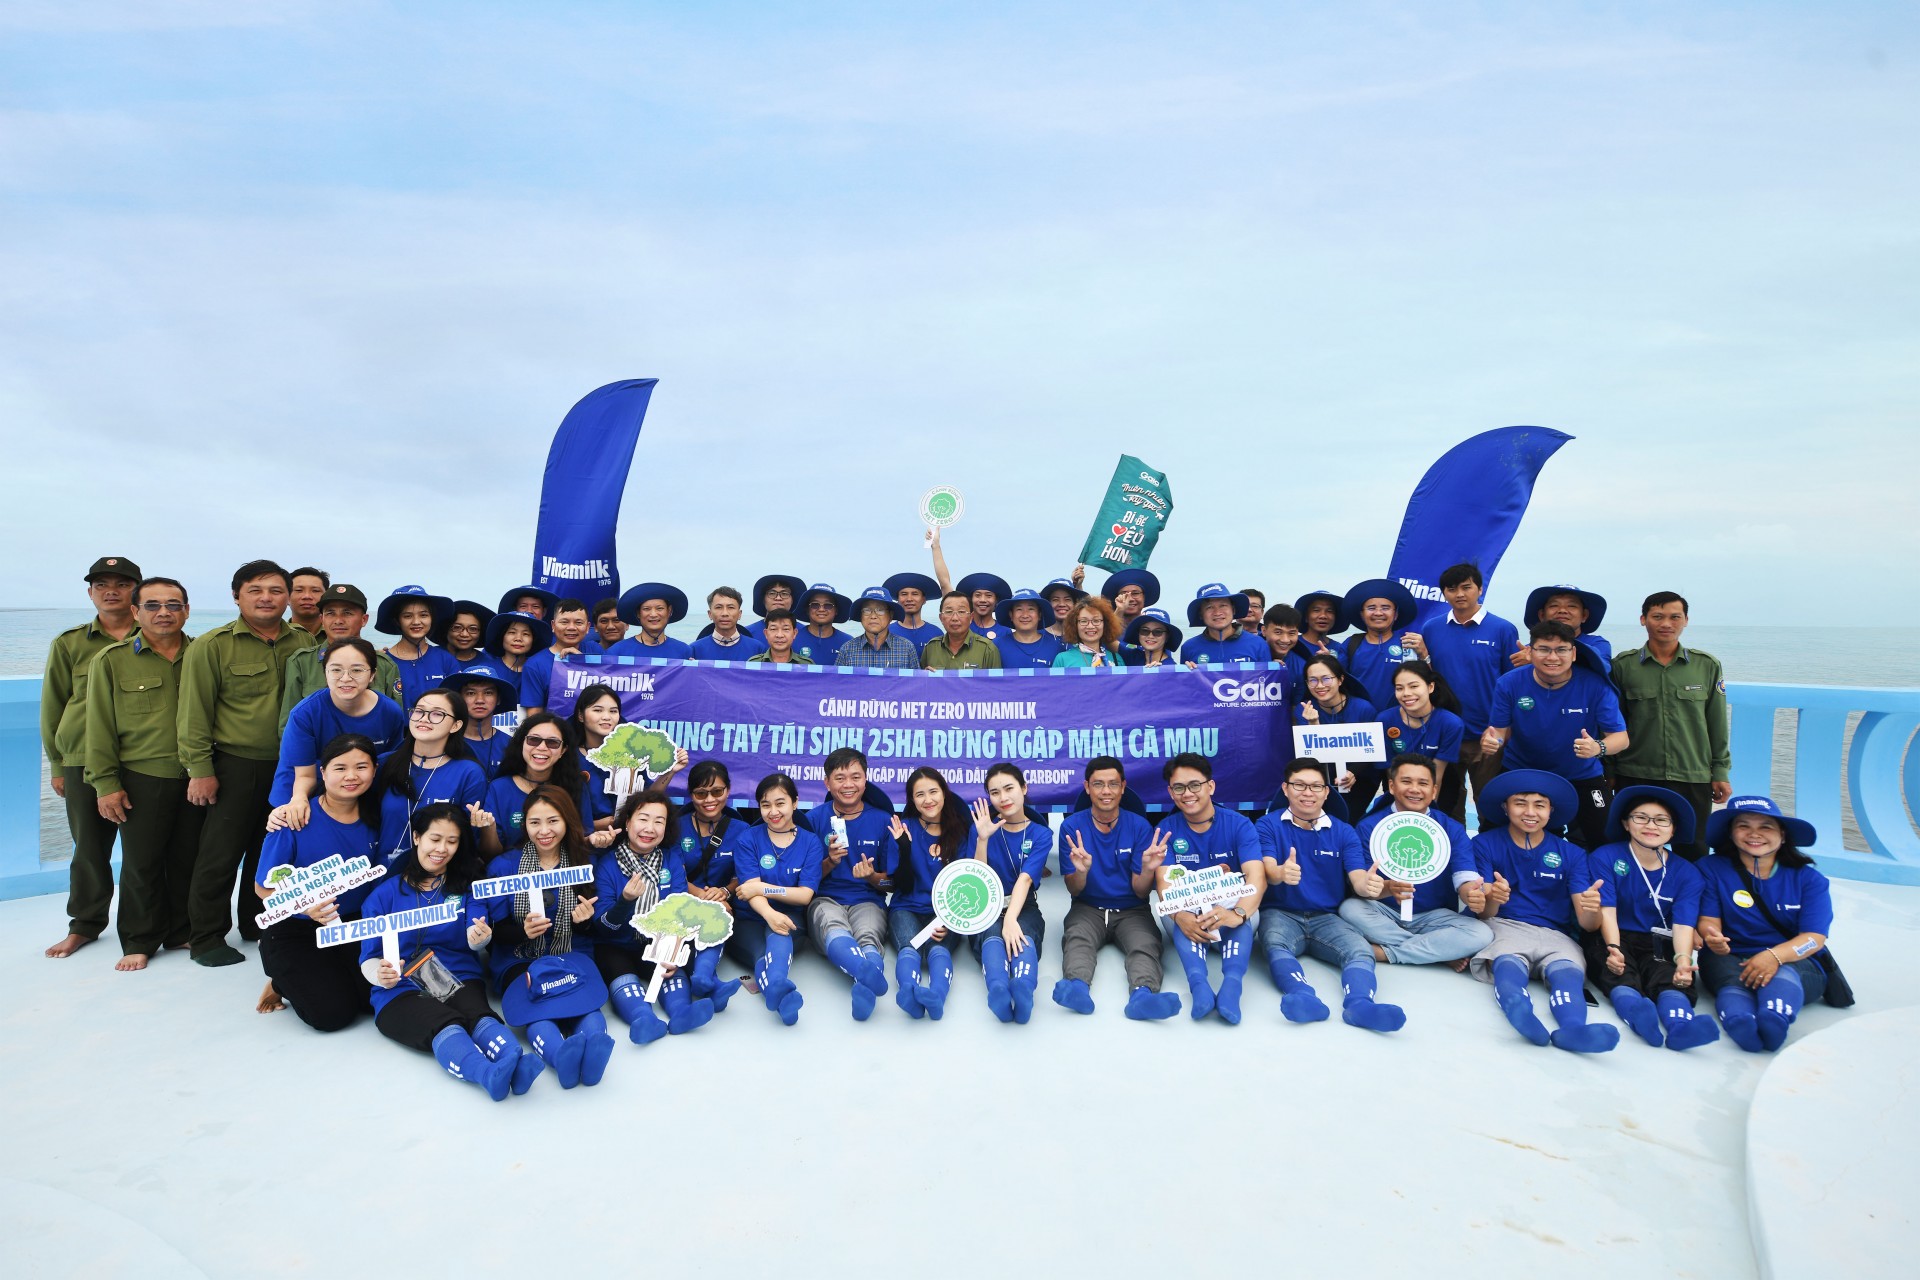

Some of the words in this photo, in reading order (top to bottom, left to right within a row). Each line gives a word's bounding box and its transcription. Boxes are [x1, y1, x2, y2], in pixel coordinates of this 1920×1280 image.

[542, 555, 610, 580] Vinamilk
[566, 669, 655, 692] Vinamilk
[1213, 676, 1282, 702] Gaia
[563, 690, 575, 698] EST
[640, 692, 654, 700] 1976
[818, 697, 857, 717] CÁNH
[859, 699, 898, 719] RỪNG
[900, 701, 927, 719] NET
[929, 702, 965, 720] ZERO
[967, 702, 1037, 720] VINAMILK
[720, 722, 765, 753] TAY
[768, 722, 805, 755] TÁI
[809, 726, 863, 756] SINH
[867, 728, 927, 757] 25HA
[932, 726, 997, 759] RỪNG
[1001, 726, 1064, 762] NGẬP
[1128, 725, 1160, 758] CÀ
[1163, 728, 1219, 758] MAU
[1302, 731, 1374, 749] Vinamilk
[866, 766, 896, 784] NGẬP
[1022, 769, 1075, 785] CARBON"
[288, 869, 310, 885] TÁI
[311, 856, 341, 876] SINH
[1181, 873, 1197, 886] TÁI
[1198, 869, 1222, 881] SINH
[1384, 860, 1405, 875] NET
[1407, 864, 1435, 878] ZERO
[267, 887, 303, 909] RỪNG
[305, 871, 337, 893] NGẬP
[340, 858, 368, 877] MẶN
[293, 895, 315, 911] dấu
[319, 884, 346, 899] chân
[349, 867, 384, 886] carbon
[474, 882, 497, 898] NET
[500, 876, 531, 894] ZERO
[531, 868, 591, 888] VINAMILK
[1164, 887, 1191, 901] RỪNG
[1193, 881, 1218, 895] NGẬP
[1221, 876, 1242, 888] MẶN
[1183, 897, 1200, 908] dấu
[1202, 893, 1223, 904] chân
[1226, 887, 1255, 898] carbon
[937, 891, 948, 911] NET
[944, 912, 970, 929] ZERO
[320, 925, 348, 945] NET
[350, 917, 387, 939] ZERO
[388, 903, 456, 931] VINAMILK
[541, 973, 576, 992] Vinamilk
